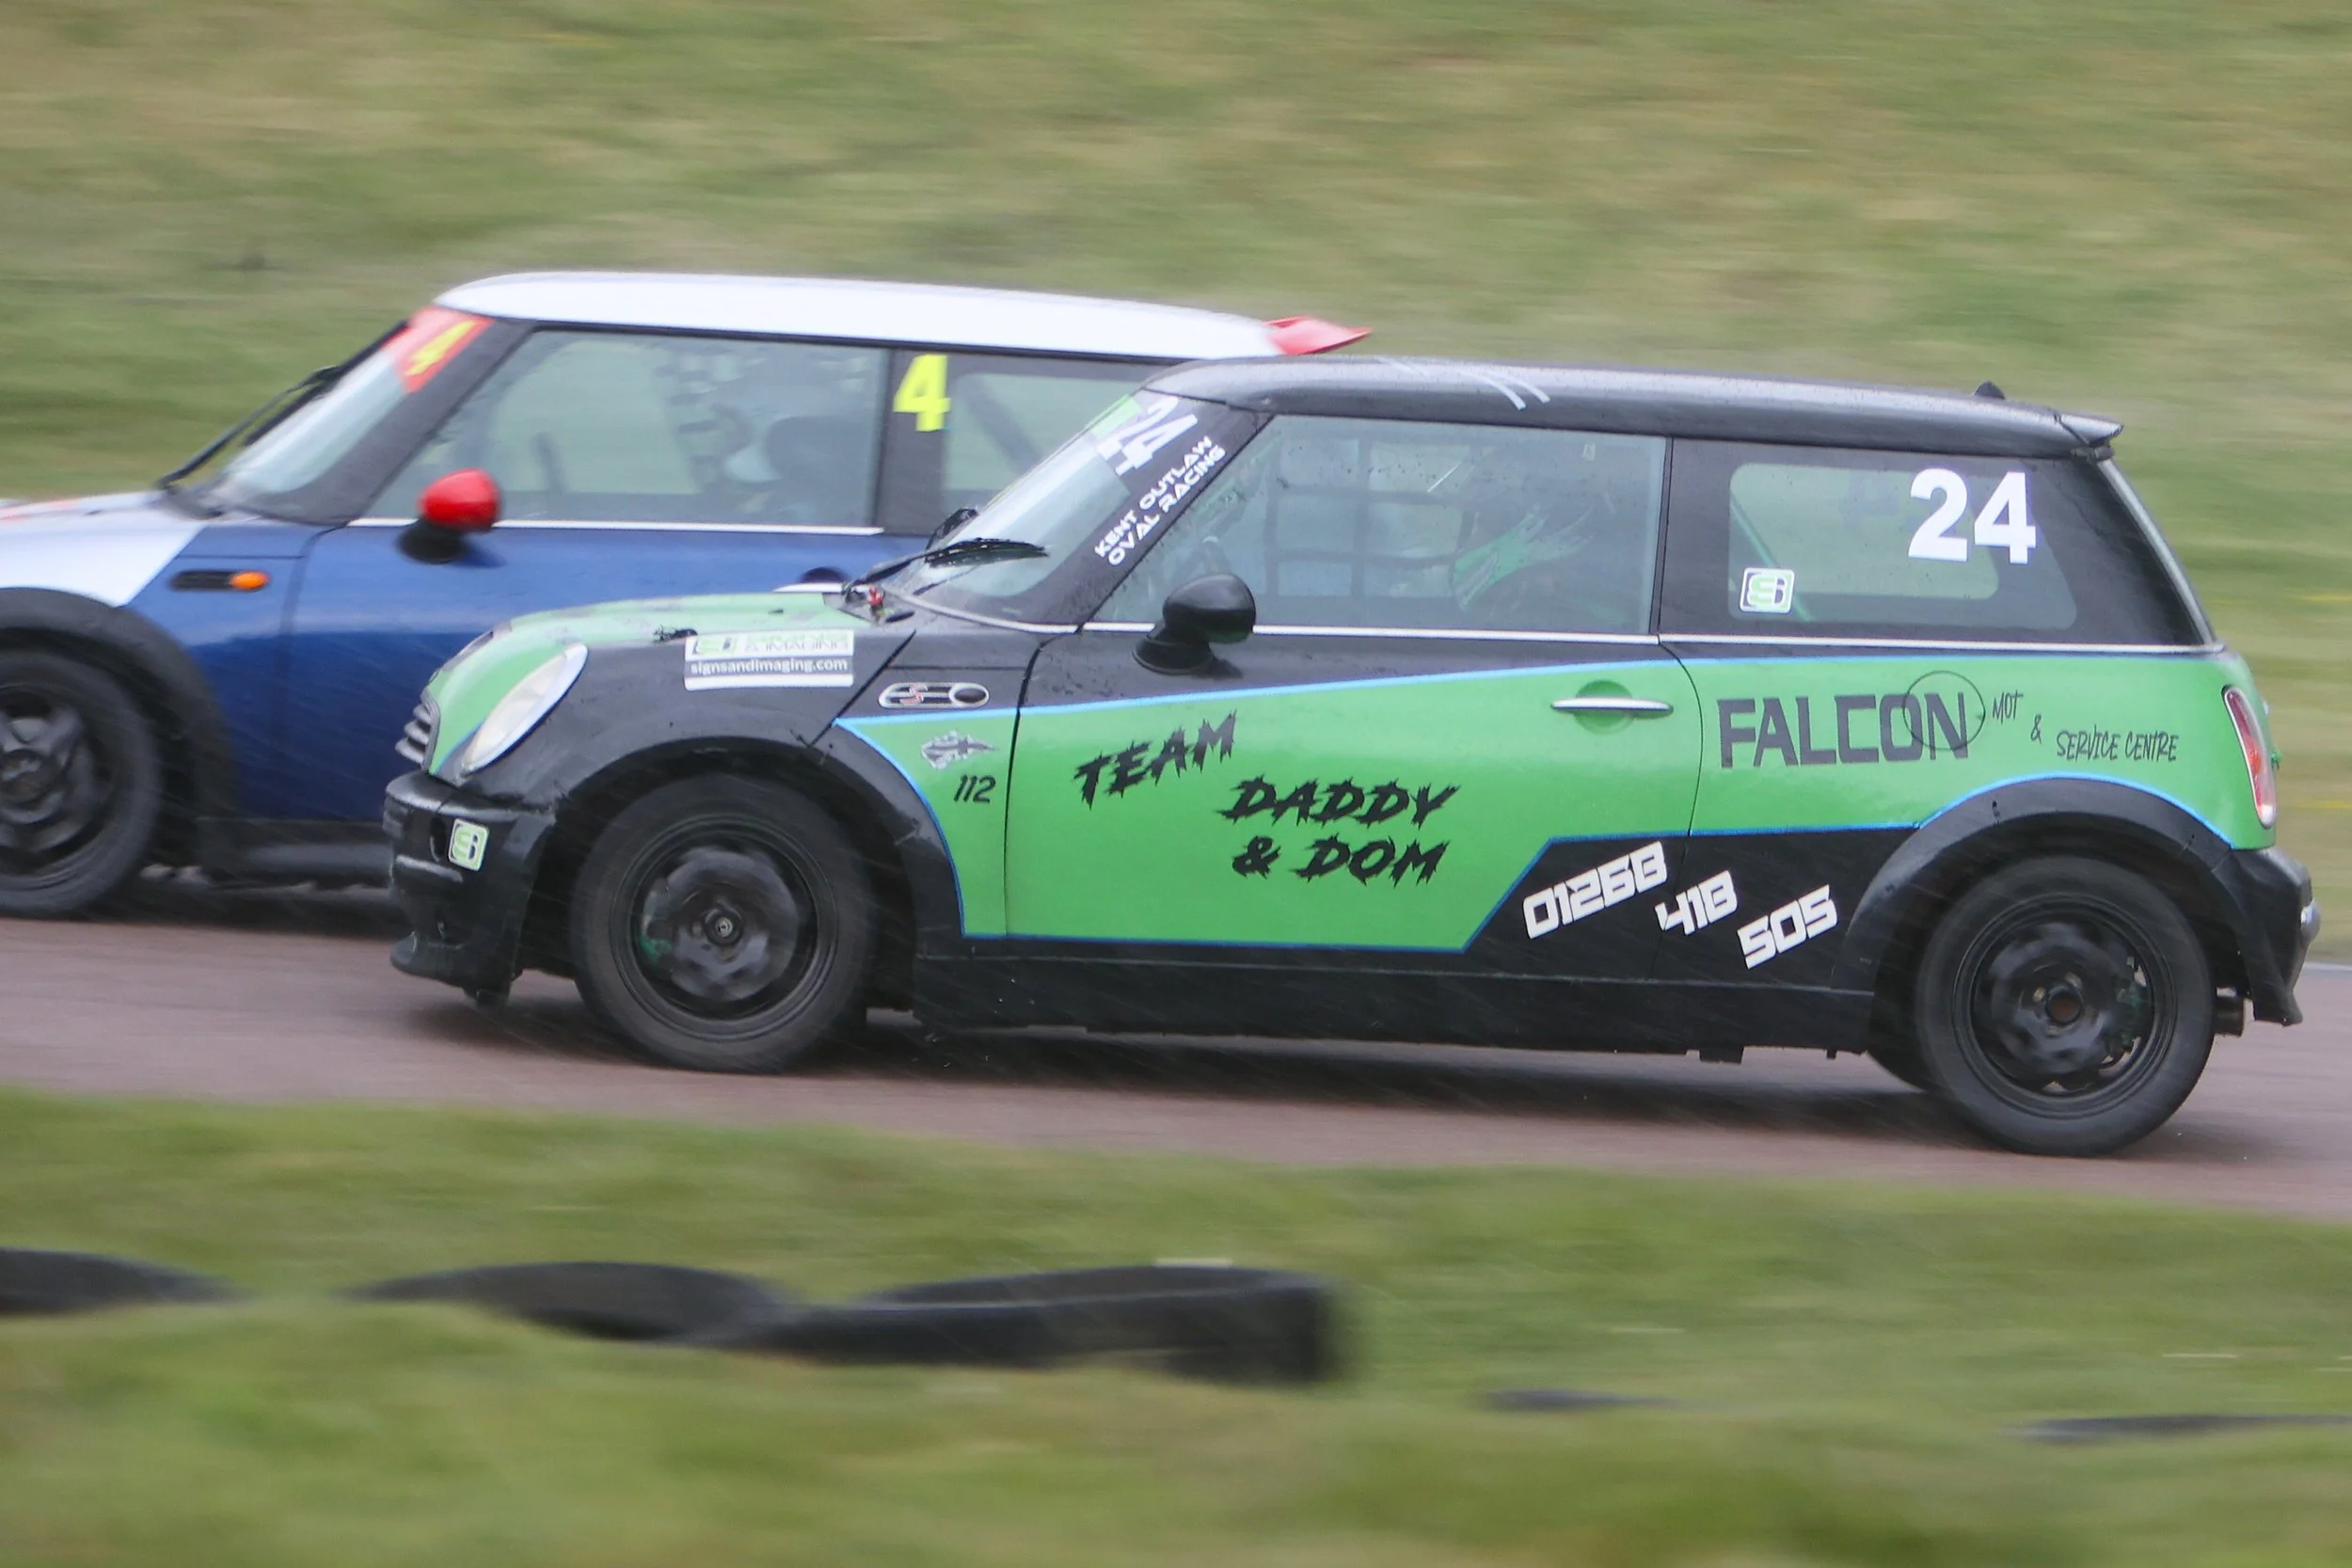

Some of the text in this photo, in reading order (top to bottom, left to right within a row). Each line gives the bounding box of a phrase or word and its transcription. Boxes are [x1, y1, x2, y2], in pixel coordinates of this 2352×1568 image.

[894, 354, 951, 432] 4
[1096, 396, 1198, 476] 24
[1094, 436, 1213, 557] KENT OUTLAW
[1108, 445, 1226, 564] OVAL RACING
[1908, 467, 2037, 565] 24
[691, 657, 848, 675] signsandimaging.com
[1073, 709, 1237, 810] TEAM
[1717, 689, 2179, 768] FALCON MOT & SERVICE CENTRE
[953, 774, 996, 804] 112
[1215, 774, 1462, 831] DADDY
[1232, 832, 1450, 888] & DOM
[1737, 884, 1838, 970] 505
